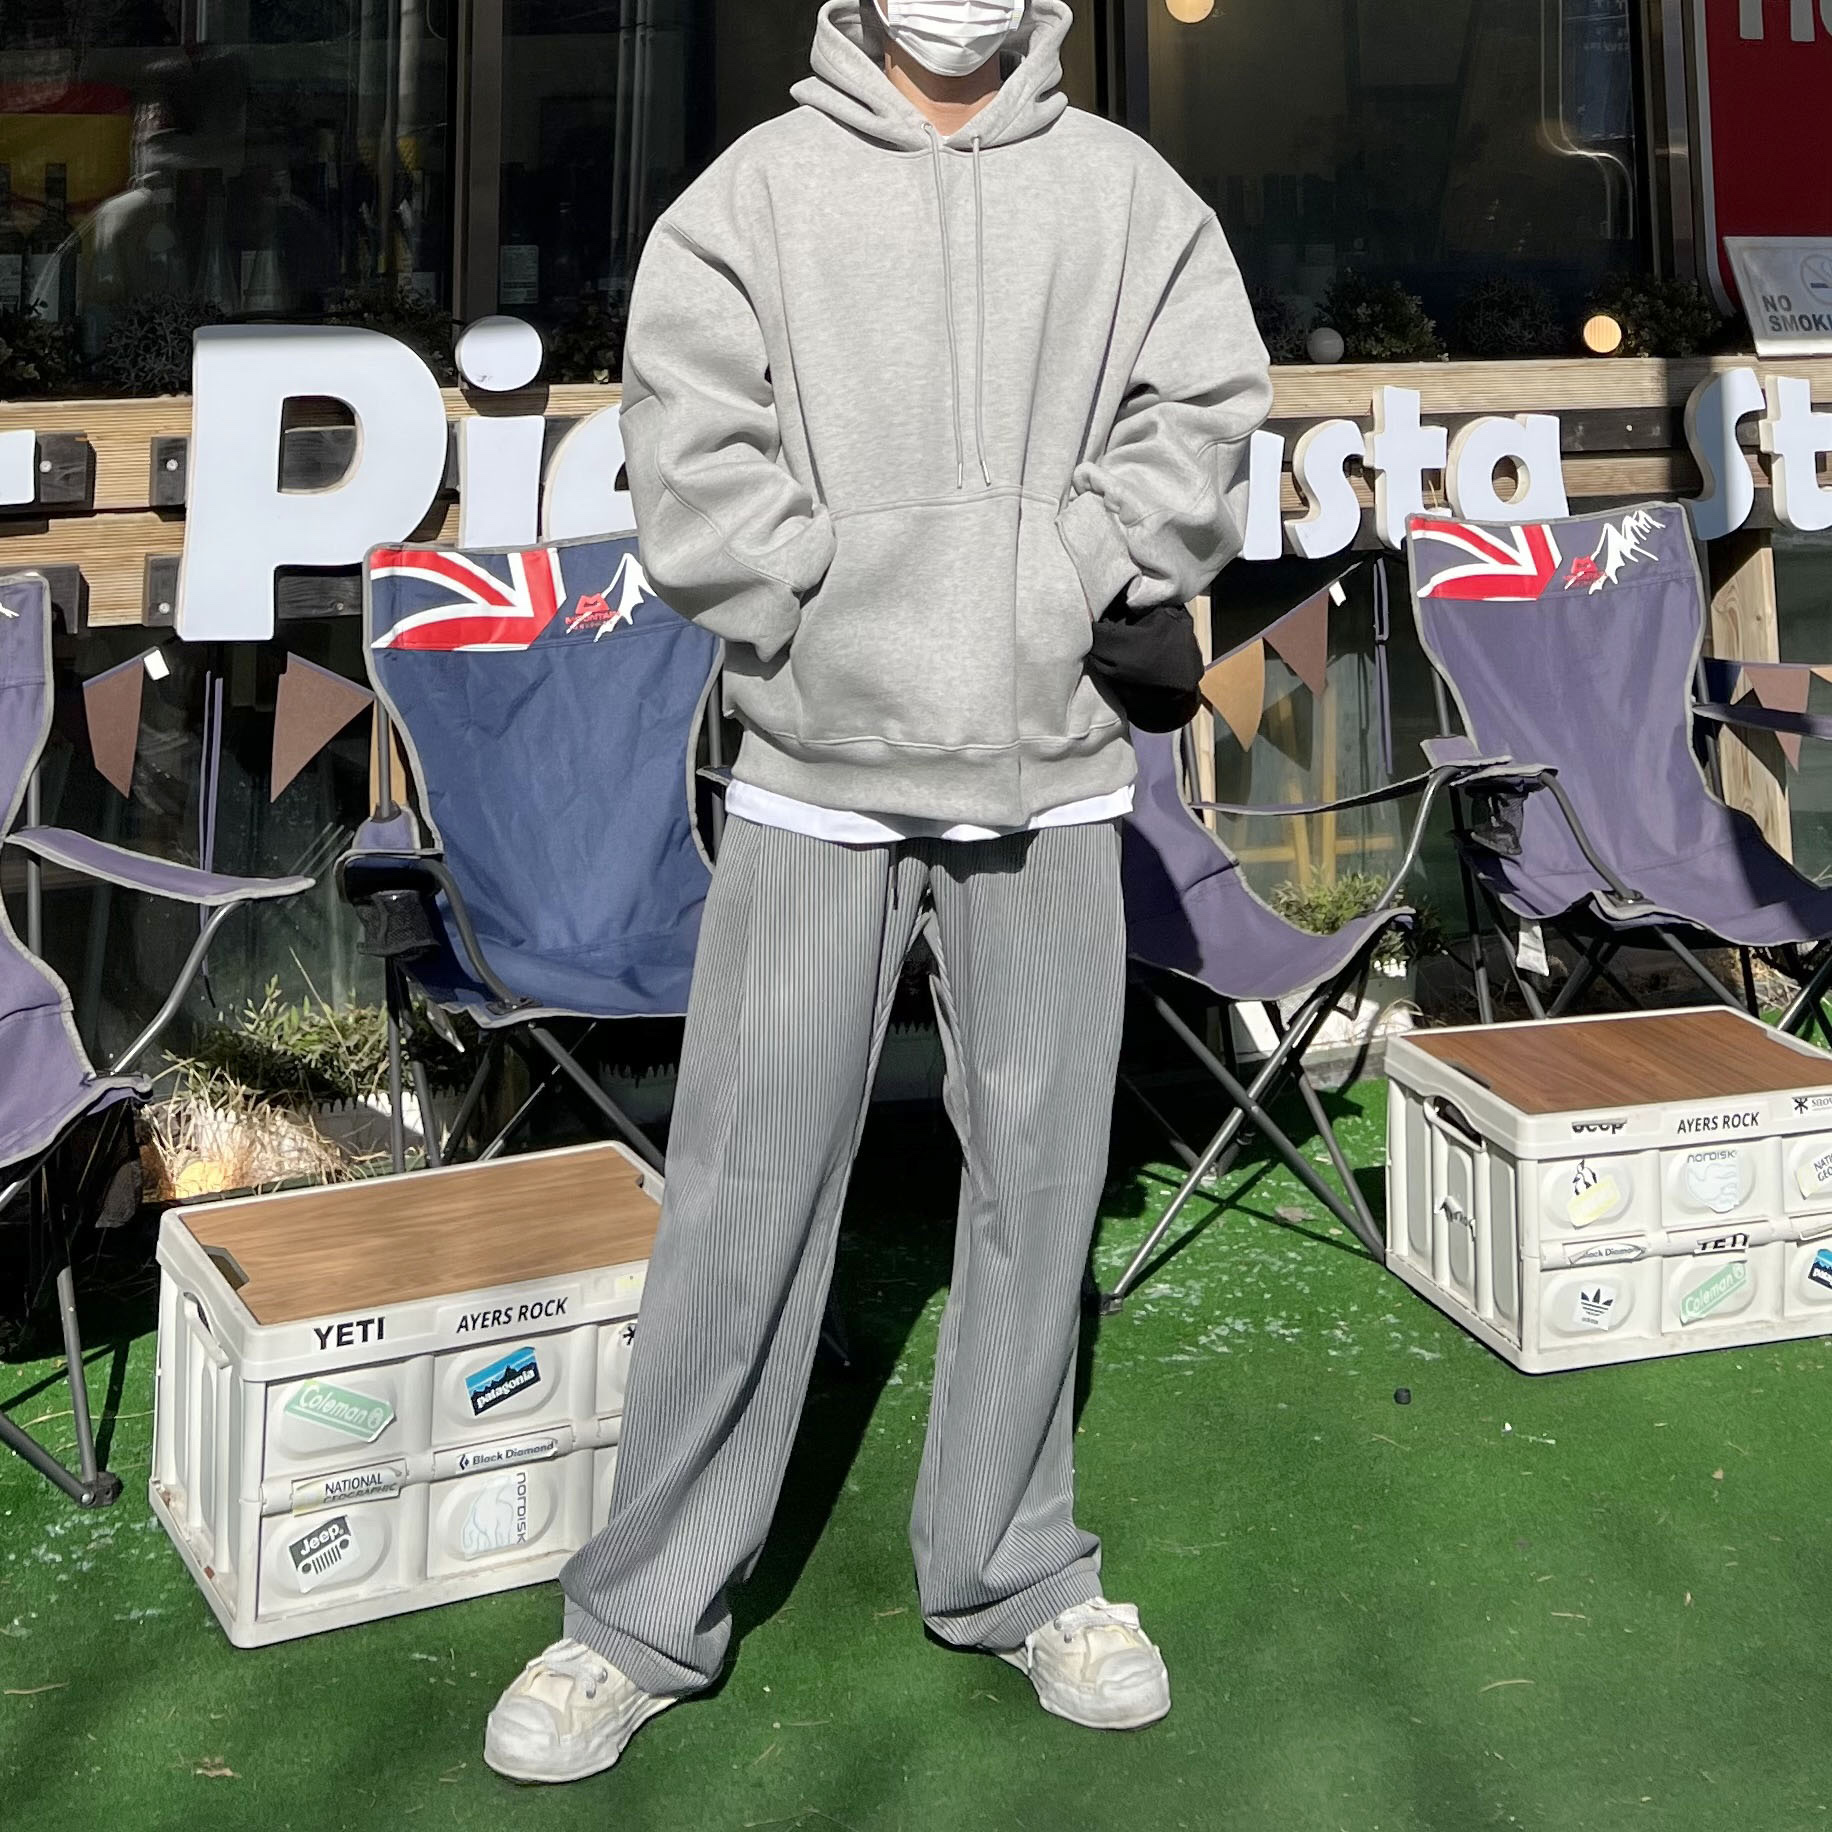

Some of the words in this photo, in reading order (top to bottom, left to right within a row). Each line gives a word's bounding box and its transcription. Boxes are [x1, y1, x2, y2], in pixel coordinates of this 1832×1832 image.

[1762, 295, 1792, 312] NO
[1677, 1115, 1719, 1135] AYERS
[1722, 1111, 1760, 1129] ROCK
[1685, 1273, 1734, 1315] Coleman
[456, 1307, 514, 1334] AYERS
[517, 1297, 568, 1322] ROCK
[313, 1316, 386, 1350] YETI
[300, 1384, 369, 1424] Coleman
[476, 1368, 536, 1409] patagonia
[472, 1452, 503, 1465] Black
[506, 1441, 554, 1459] Diamond
[325, 1472, 383, 1497] NATIONAL
[300, 1524, 340, 1556] Jeep
